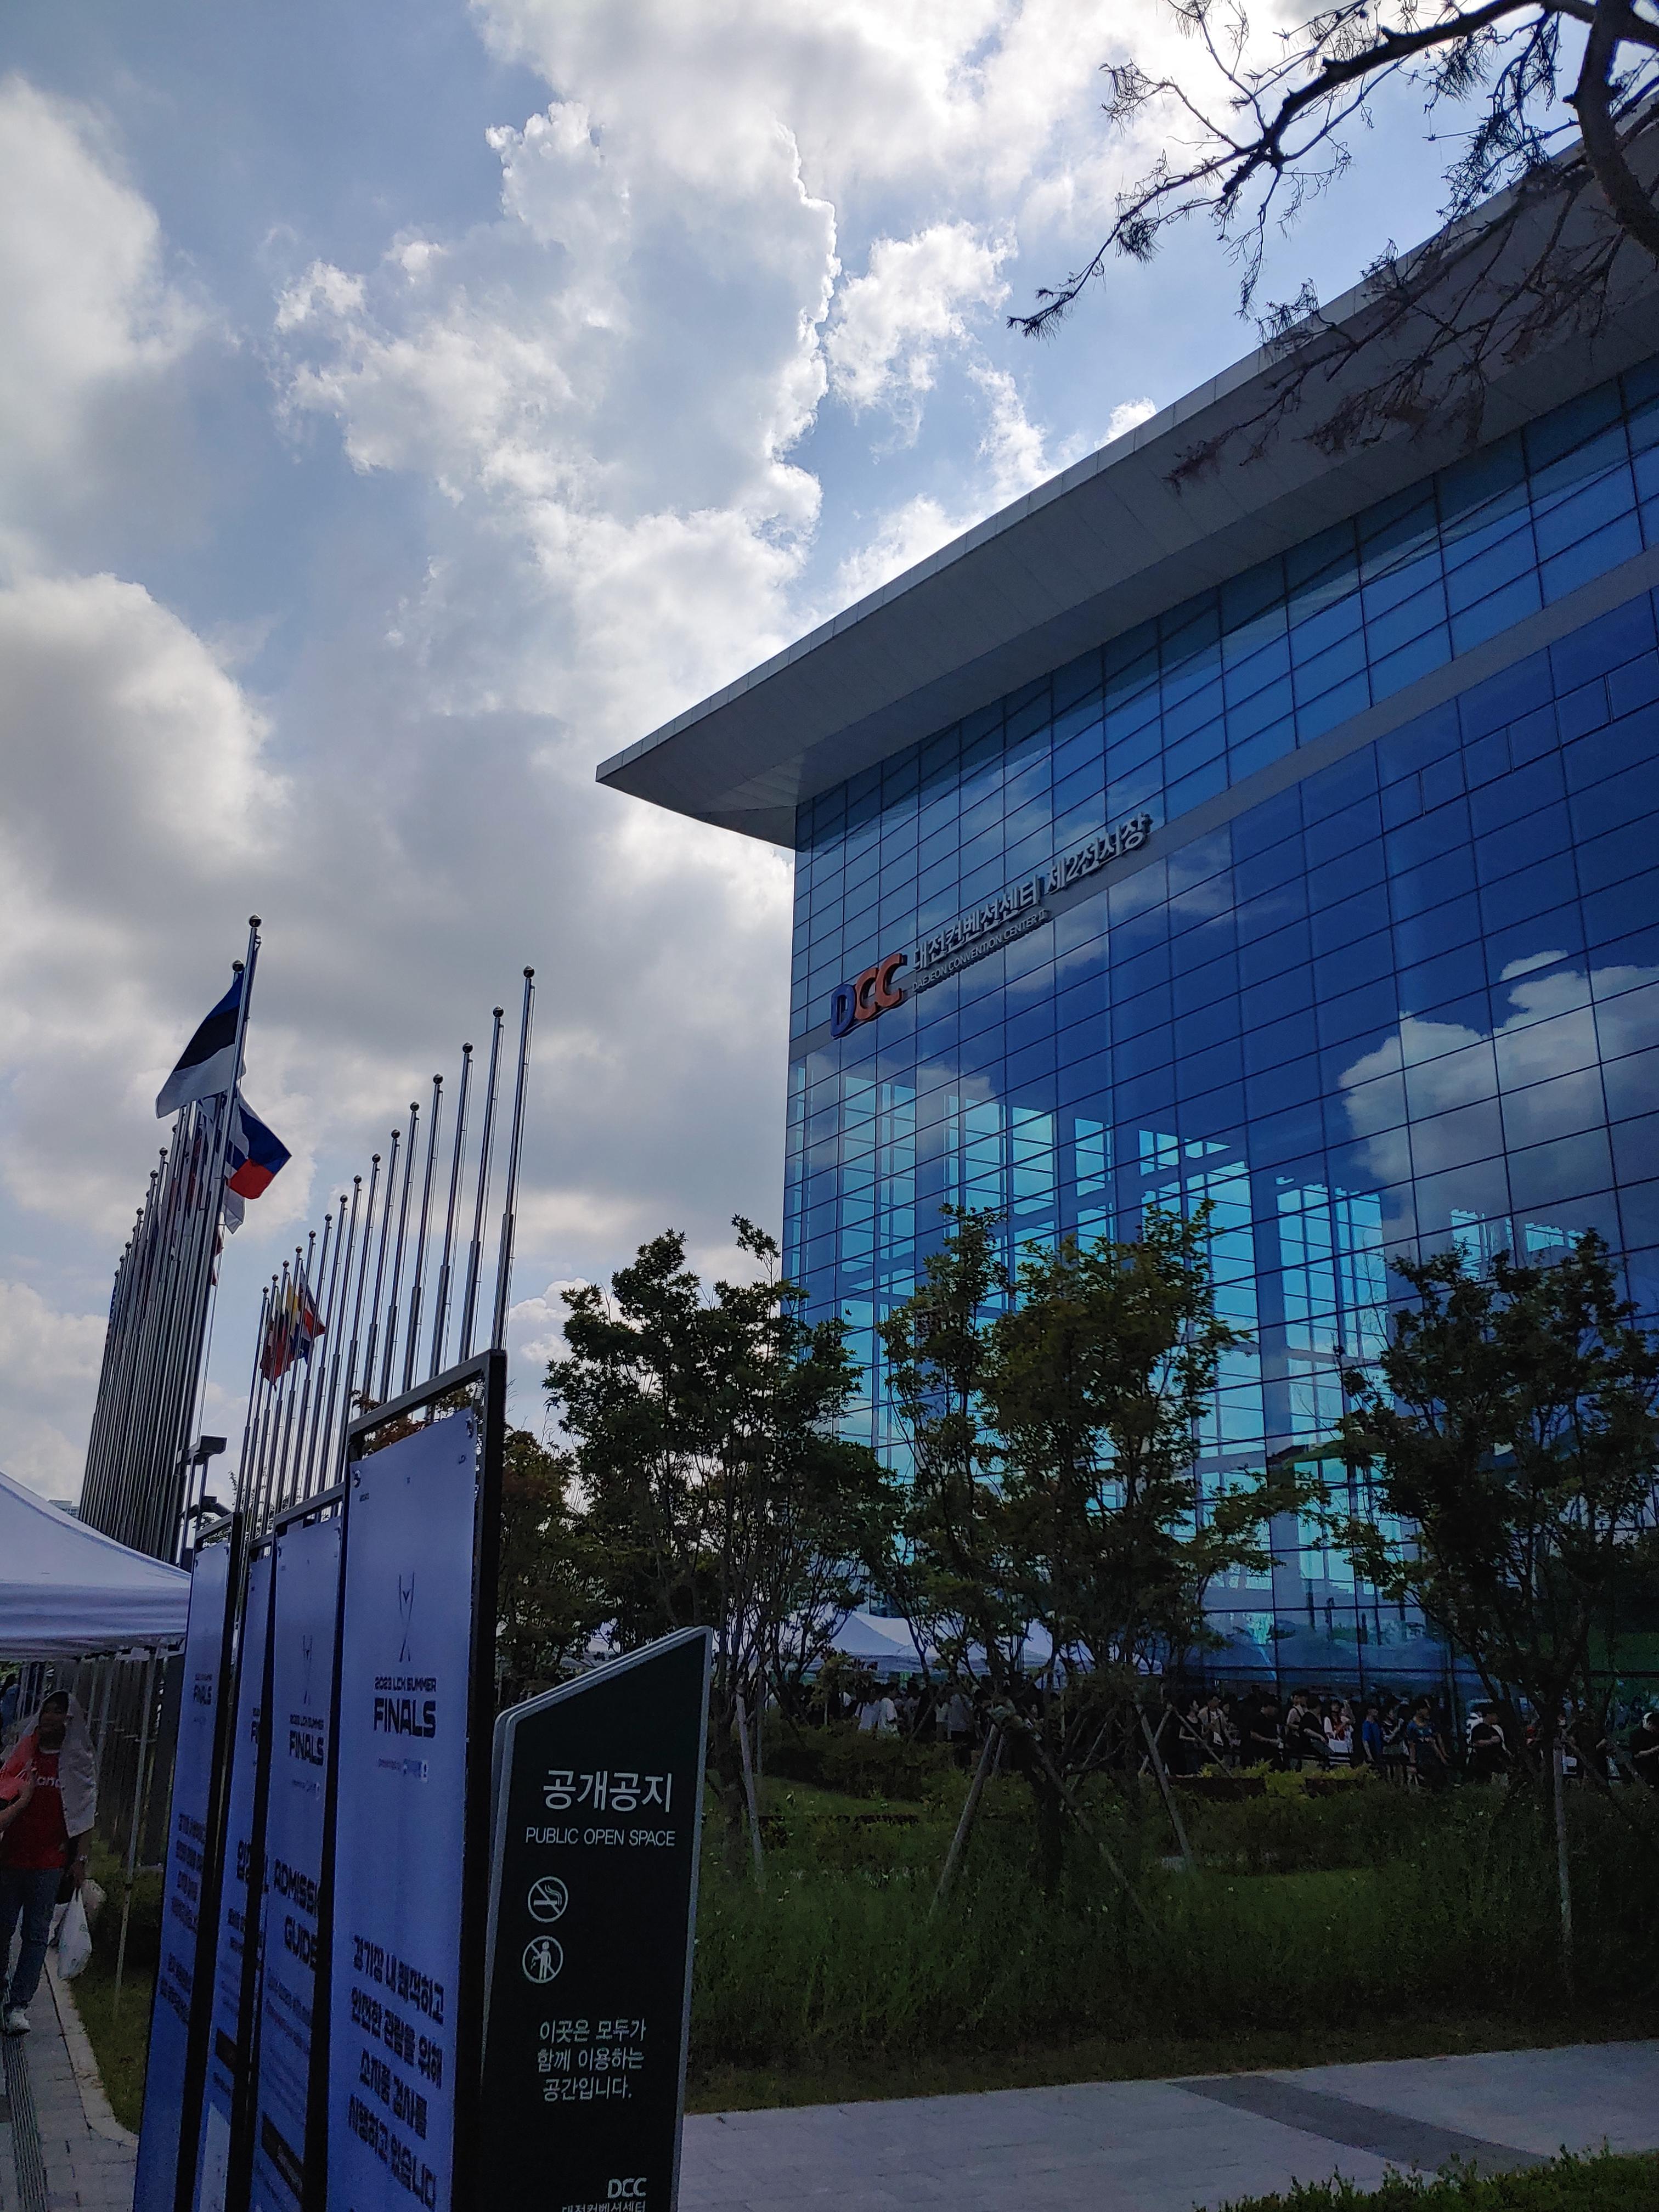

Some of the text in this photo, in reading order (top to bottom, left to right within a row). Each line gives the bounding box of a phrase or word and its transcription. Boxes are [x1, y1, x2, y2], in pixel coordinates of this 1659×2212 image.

[912, 812, 1151, 970] 대전컨벤션센터 제2전시장
[912, 964, 948, 991] DAEJEON
[949, 936, 1003, 971] CONVENTION
[1003, 914, 1037, 940] CENTER
[830, 953, 907, 1039] DCC
[374, 1697, 436, 1738] FINALS
[290, 1730, 324, 1766] FINALS
[543, 1769, 673, 1813] 공개공지
[526, 1827, 676, 1847] PUBLIC OPEN SPACE
[274, 1859, 319, 1917] ADMISSI
[539, 2018, 646, 2045] 이곳은 모두가
[537, 2047, 645, 2073] 함께 이용하는
[543, 2076, 632, 2102] 공간입니다.
[607, 2178, 647, 2198] DCC
